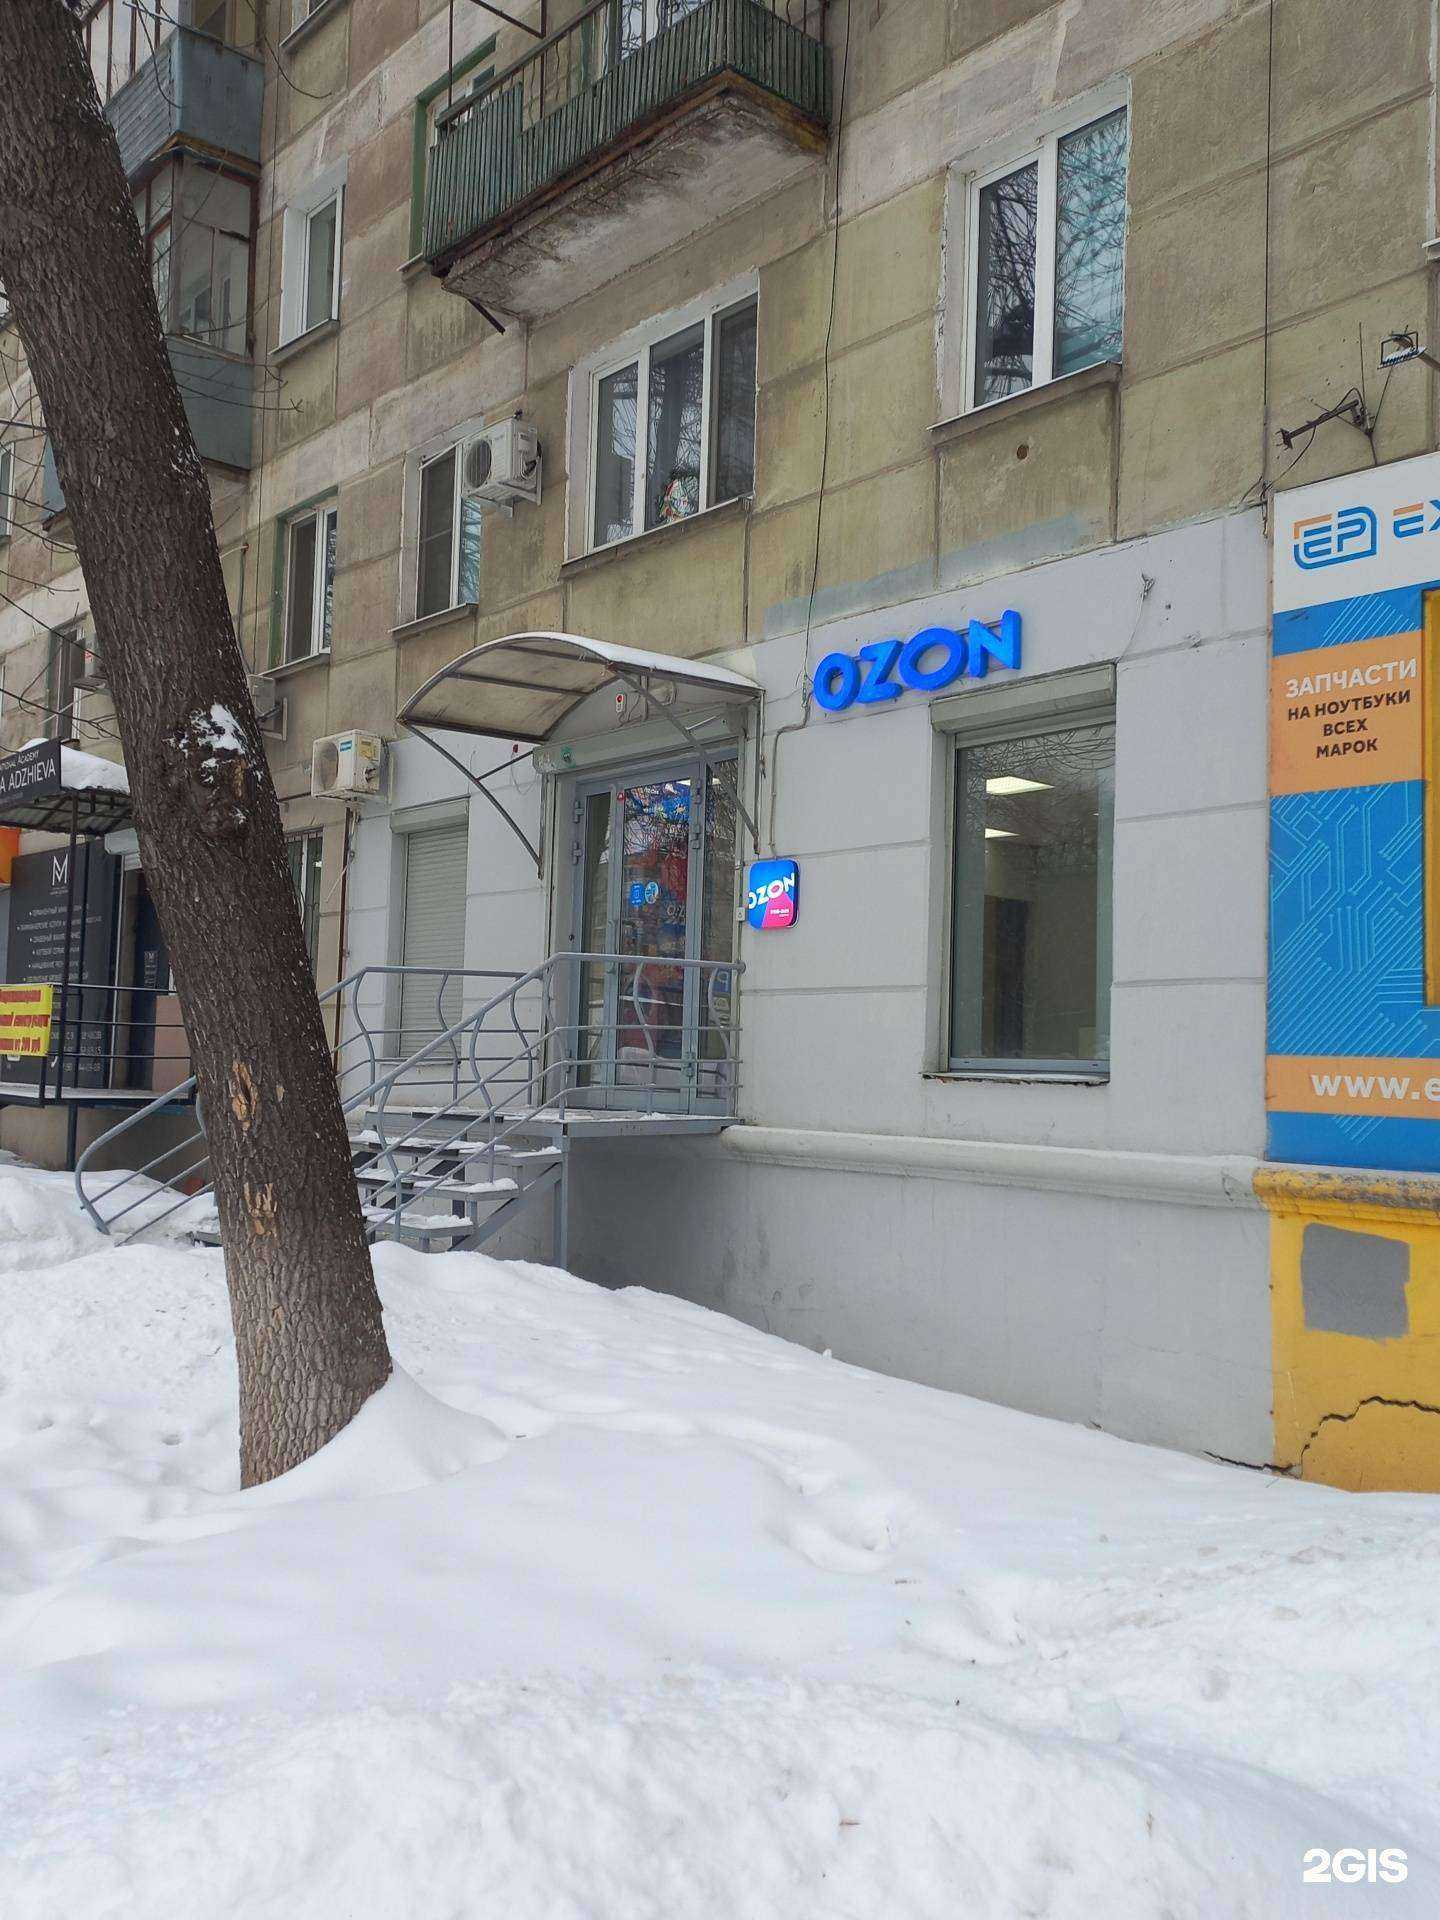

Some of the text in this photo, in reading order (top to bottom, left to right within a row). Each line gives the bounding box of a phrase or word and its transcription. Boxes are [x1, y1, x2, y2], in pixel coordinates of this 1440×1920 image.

[814, 610, 1021, 711] OZON
[1286, 658, 1417, 698] ЗАПЧАСТИ
[1288, 689, 1411, 721] НА НОУТБУКИ
[1323, 718, 1368, 736] ВСЕХ
[1316, 738, 1378, 758] МАРОК
[8, 758, 56, 791] ADZHIEVA
